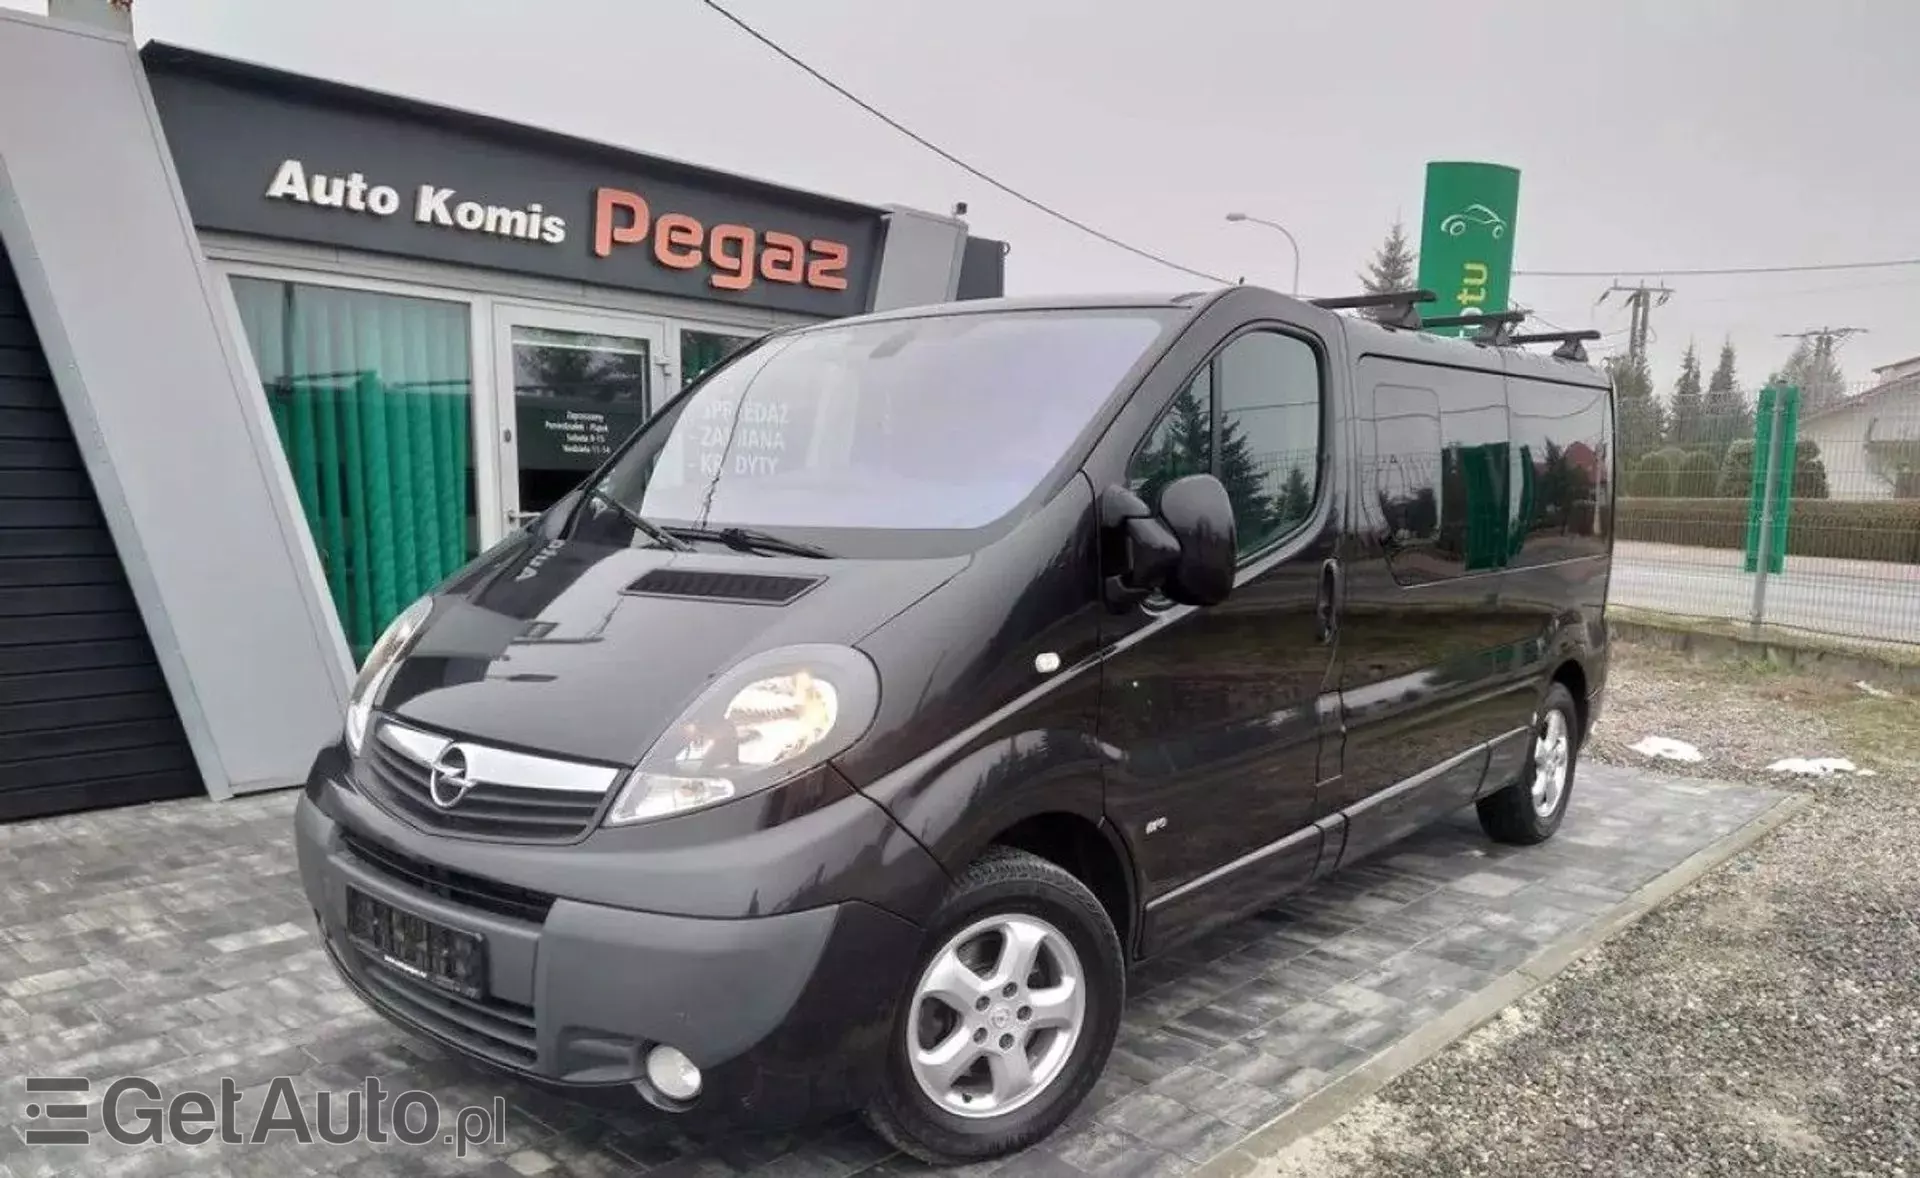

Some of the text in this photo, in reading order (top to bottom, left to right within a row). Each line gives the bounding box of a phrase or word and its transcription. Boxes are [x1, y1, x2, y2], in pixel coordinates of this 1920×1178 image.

[266, 160, 849, 290] Auto Komis Pegaz
